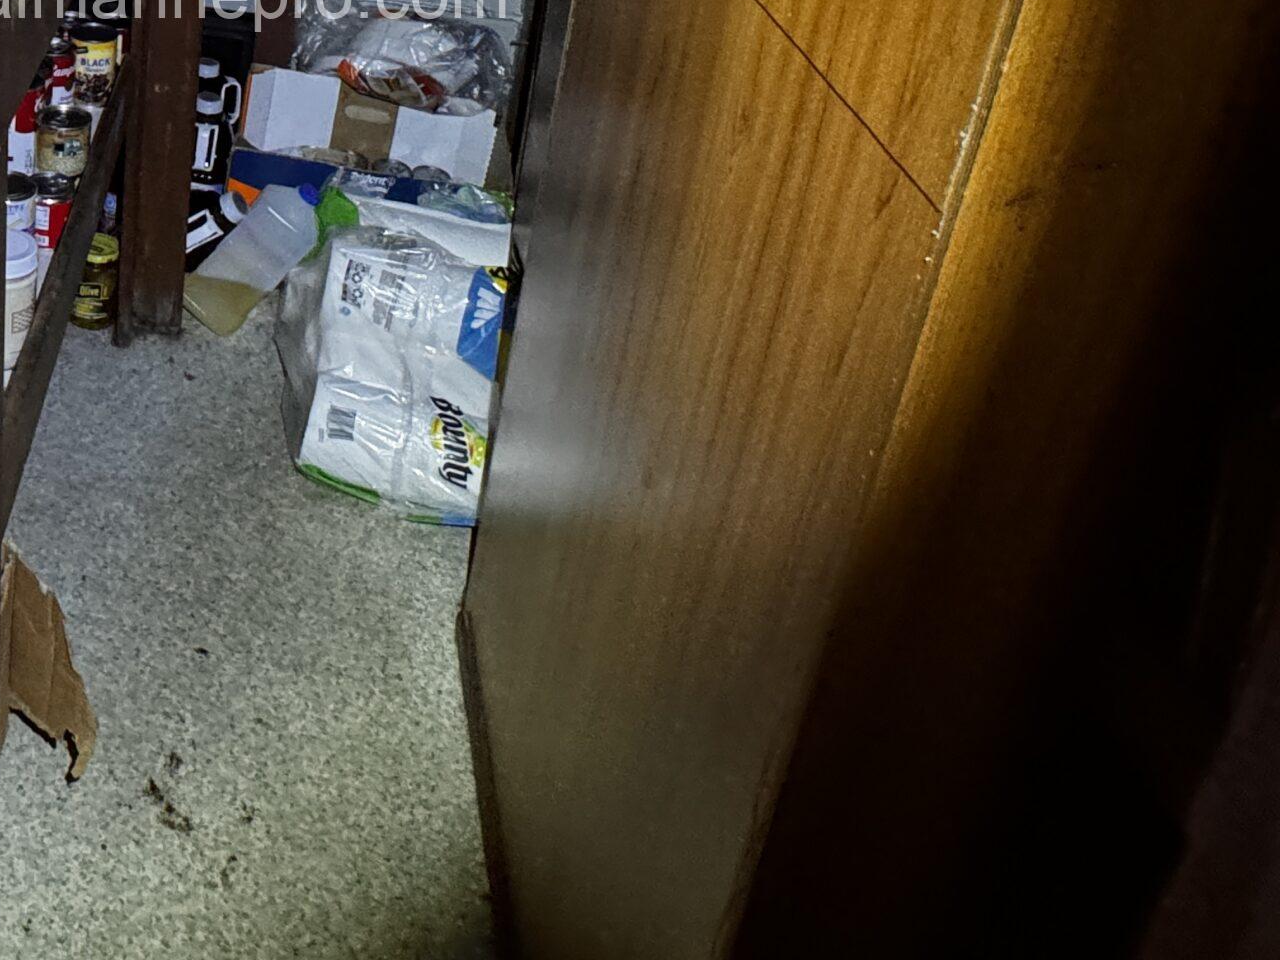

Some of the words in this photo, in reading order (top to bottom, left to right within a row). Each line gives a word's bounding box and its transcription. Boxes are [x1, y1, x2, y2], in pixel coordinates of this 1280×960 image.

[80, 57, 111, 67] BLACK
[79, 285, 100, 296] Olive
[430, 395, 468, 490] Bounty
